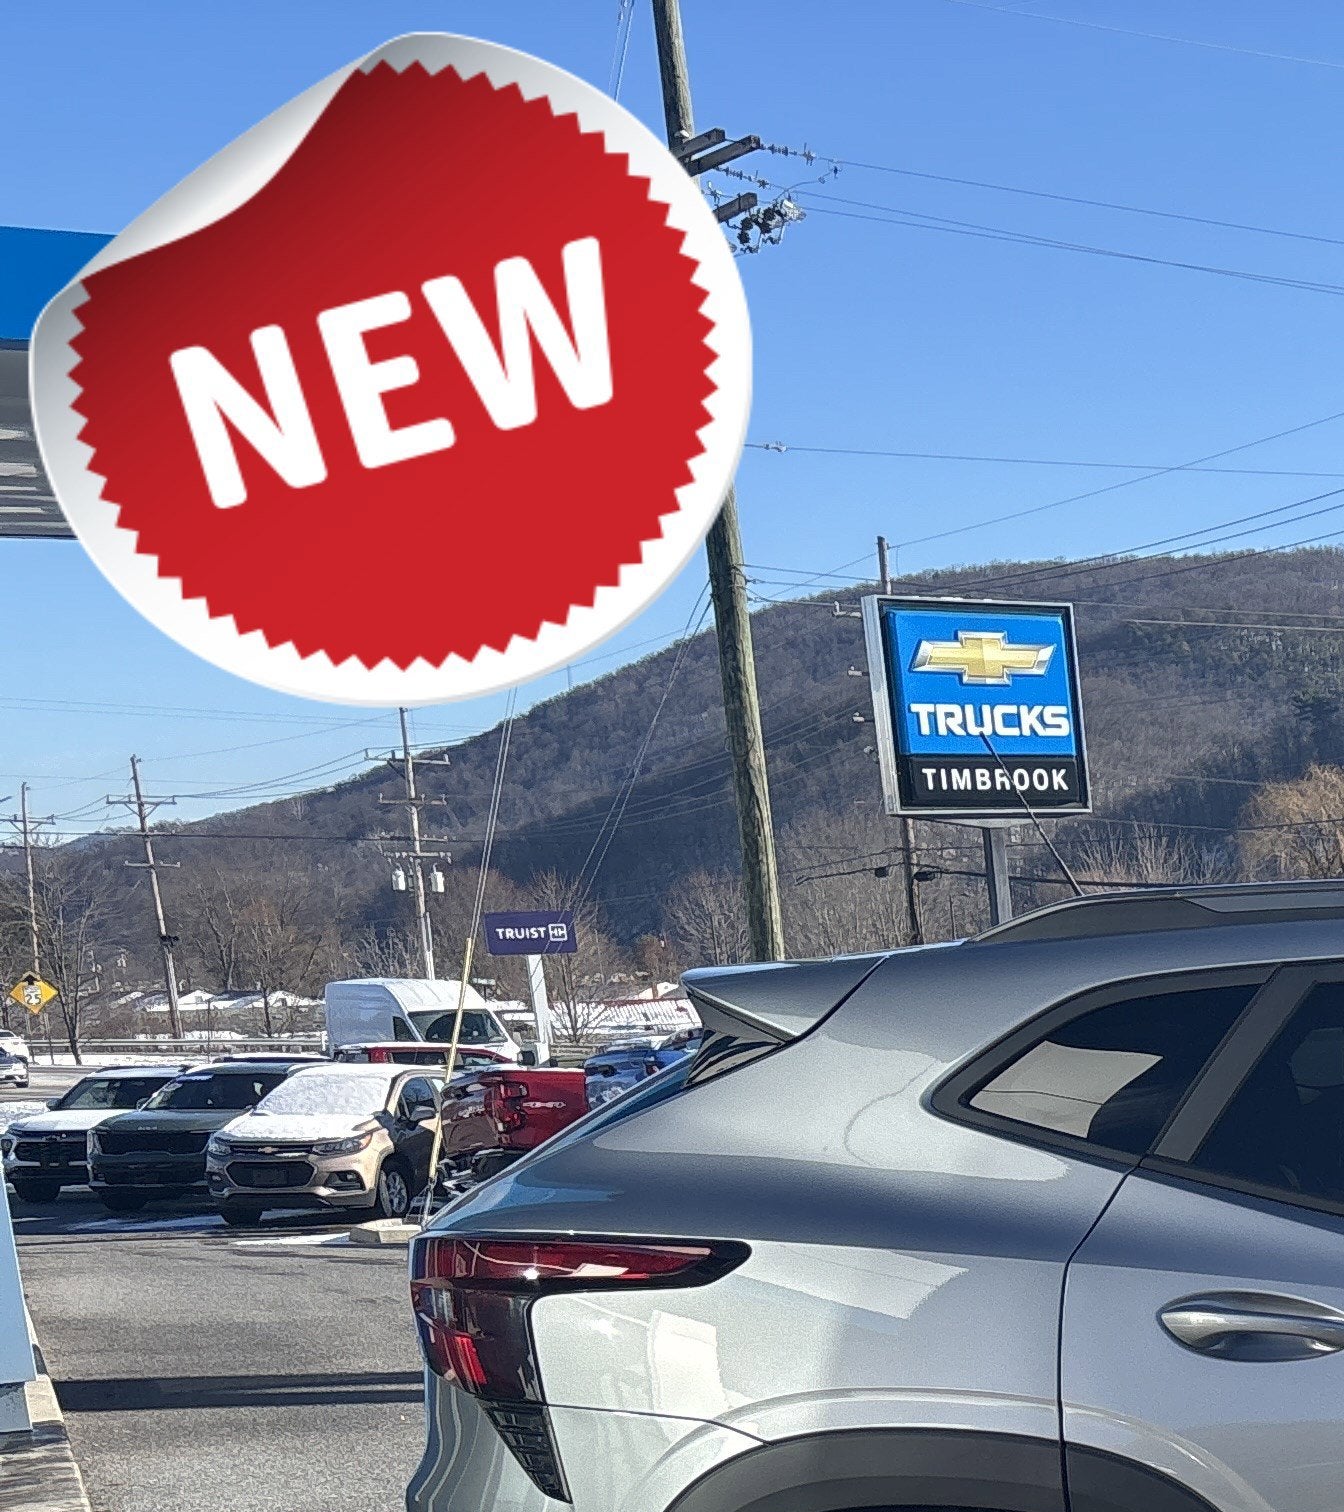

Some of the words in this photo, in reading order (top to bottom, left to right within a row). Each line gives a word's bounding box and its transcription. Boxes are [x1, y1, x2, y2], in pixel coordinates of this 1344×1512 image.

[910, 703, 1070, 736] TRUCKS
[922, 768, 1069, 791] TIMBROOK
[495, 927, 546, 939] TRUIST
[25, 993, 41, 1004] 25
